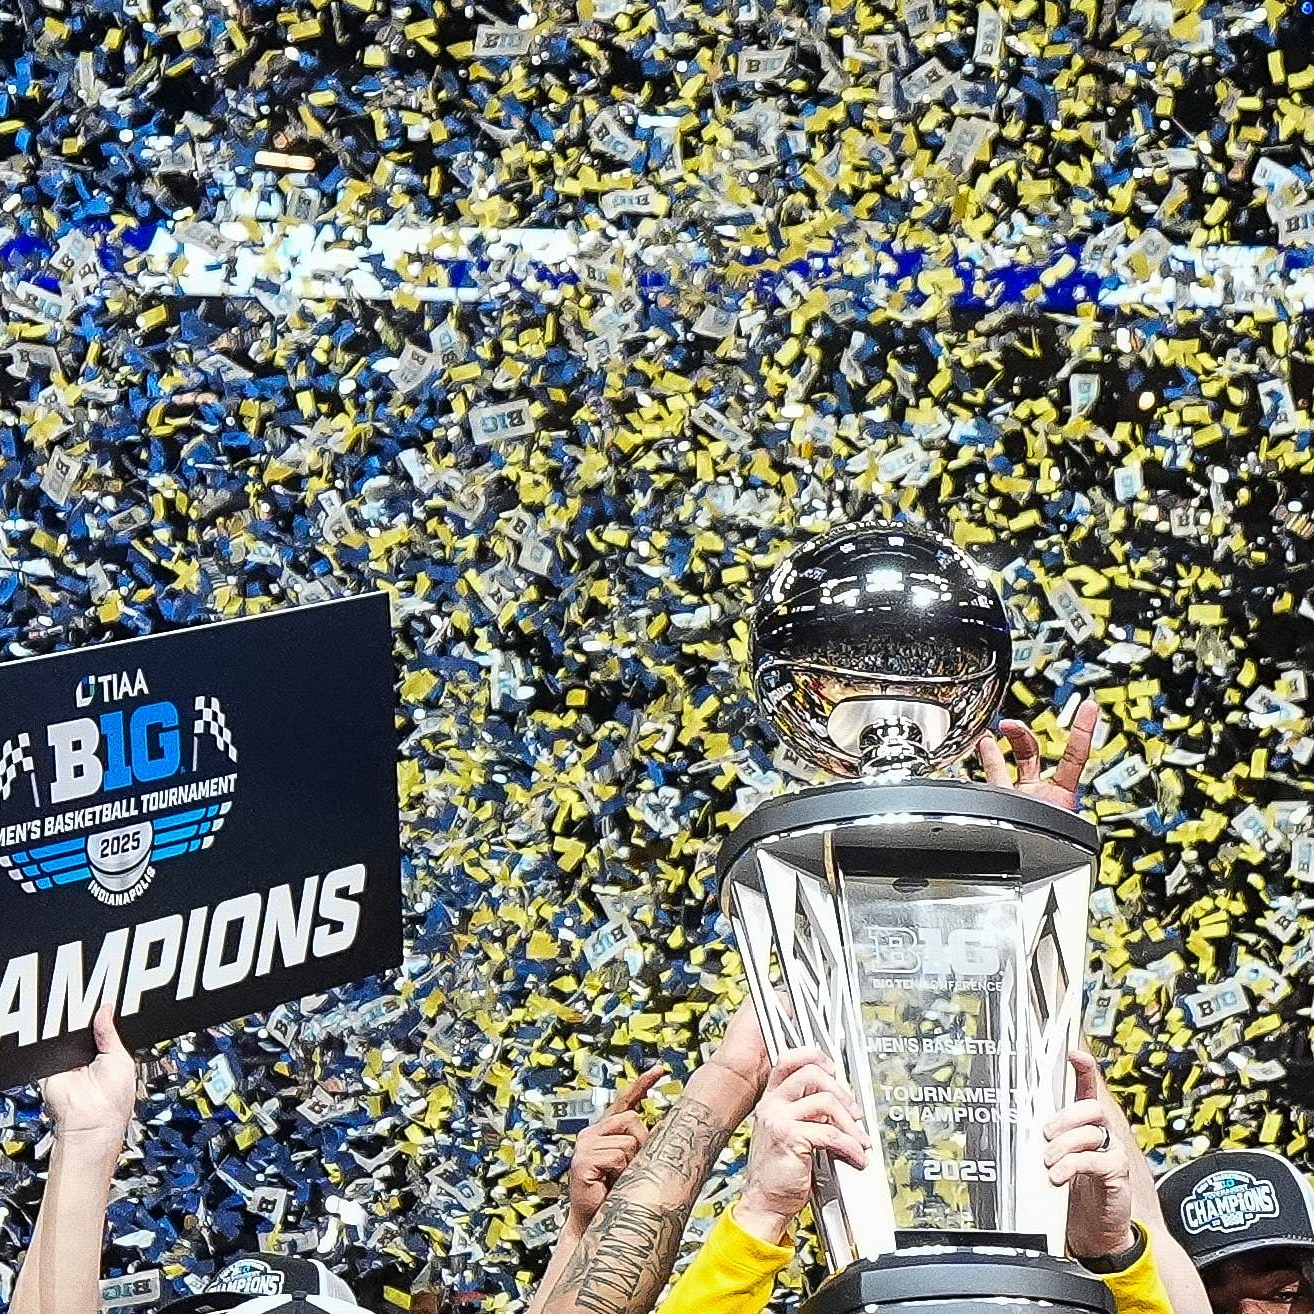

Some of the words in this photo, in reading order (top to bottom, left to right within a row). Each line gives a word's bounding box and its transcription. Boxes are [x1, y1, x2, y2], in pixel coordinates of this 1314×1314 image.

[98, 668, 149, 703] TIAA
[44, 797, 138, 838] BASKETBALL
[140, 773, 238, 813] TOURNAMENT
[100, 831, 141, 858] 2025
[87, 866, 156, 906] INDIANAPOLIS
[867, 1038, 919, 1053] MEN'S
[923, 1160, 997, 1182] 2025
[1186, 1187, 1274, 1227] CHAMPIONS
